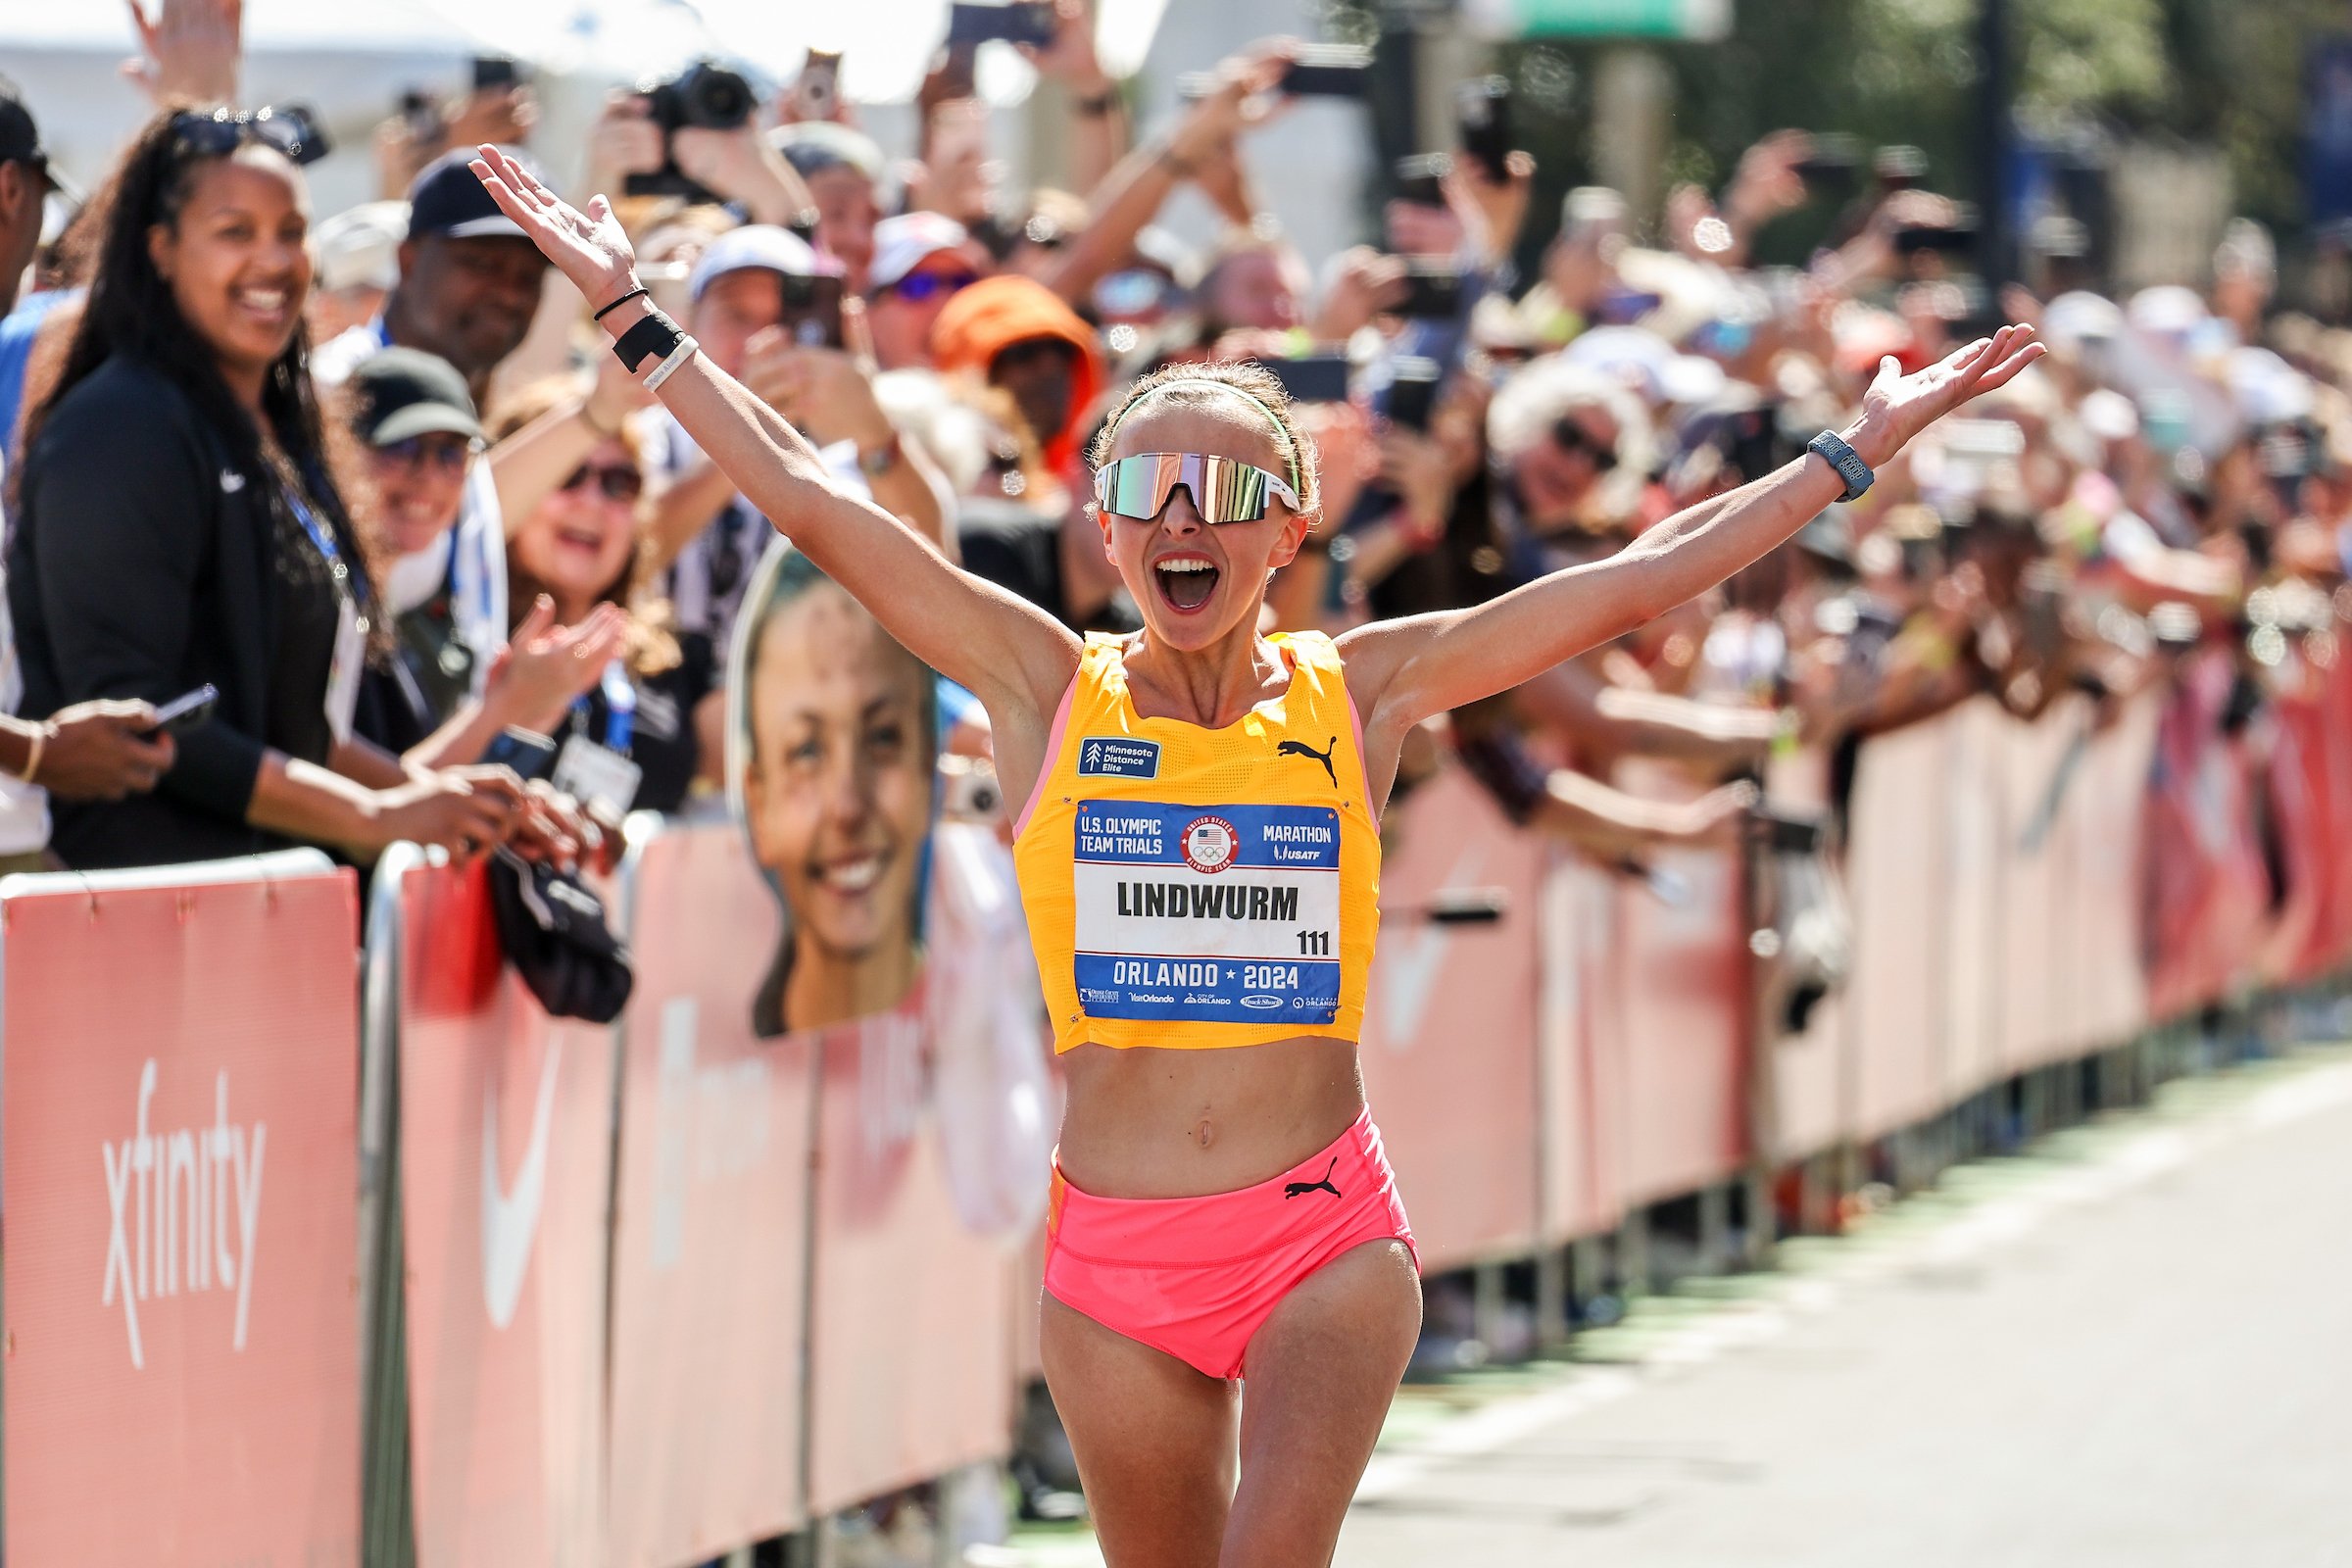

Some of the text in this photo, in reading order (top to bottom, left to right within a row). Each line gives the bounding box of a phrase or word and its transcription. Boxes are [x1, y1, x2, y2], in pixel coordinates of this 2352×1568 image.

[1103, 754, 1145, 765] Distance
[1104, 745, 1153, 758] Minnesota
[1102, 762, 1122, 772] Elite
[1081, 816, 1161, 836] U.S. OLYMPIC
[1210, 817, 1233, 833] STATES
[1263, 825, 1332, 843] MARATHON
[1081, 835, 1162, 855] TEAM TRIALS
[1287, 850, 1321, 860] USATF
[1117, 881, 1298, 921] LINDWURM
[1297, 930, 1329, 956] 111
[1113, 960, 1298, 990] ORLANDO 2024
[102, 1057, 267, 1371] xfinity
